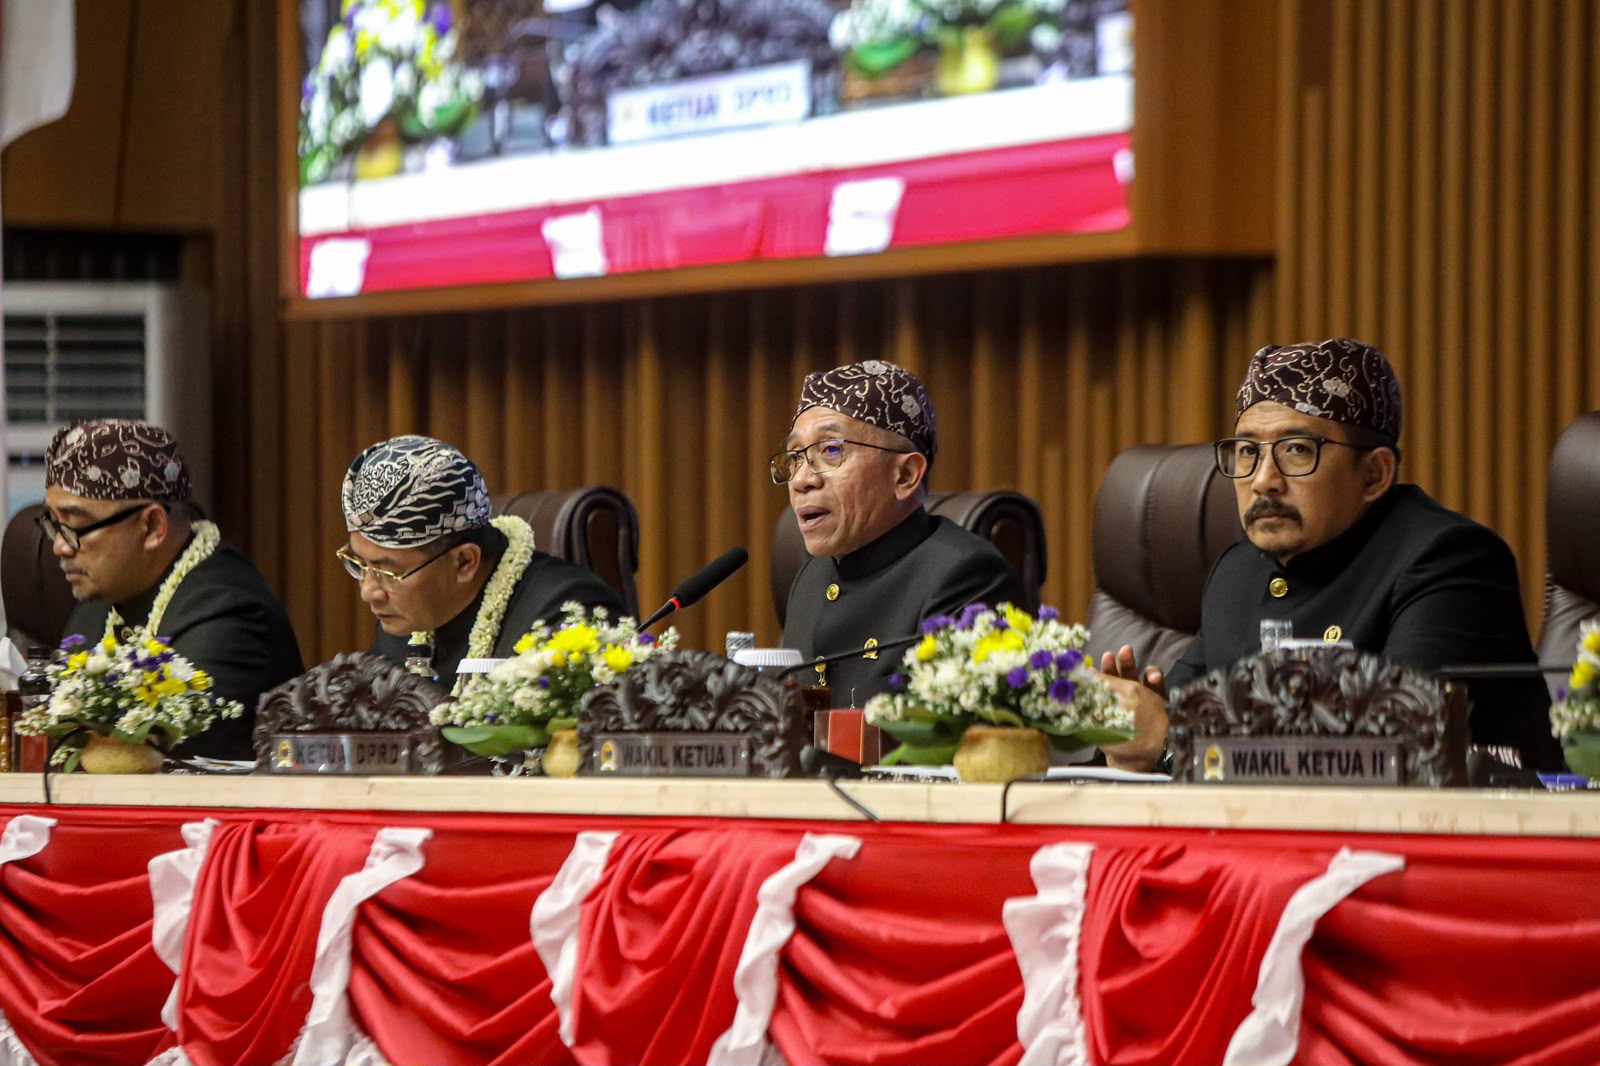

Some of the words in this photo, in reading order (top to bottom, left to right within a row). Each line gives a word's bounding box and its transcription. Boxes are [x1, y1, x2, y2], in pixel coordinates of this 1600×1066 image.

[357, 743, 399, 765] DPRD
[622, 745, 667, 767] WAKIL
[673, 745, 725, 767] KETUA
[1231, 751, 1290, 776] WAKIL
[1298, 751, 1363, 777] KETUA
[1372, 751, 1384, 777] II
